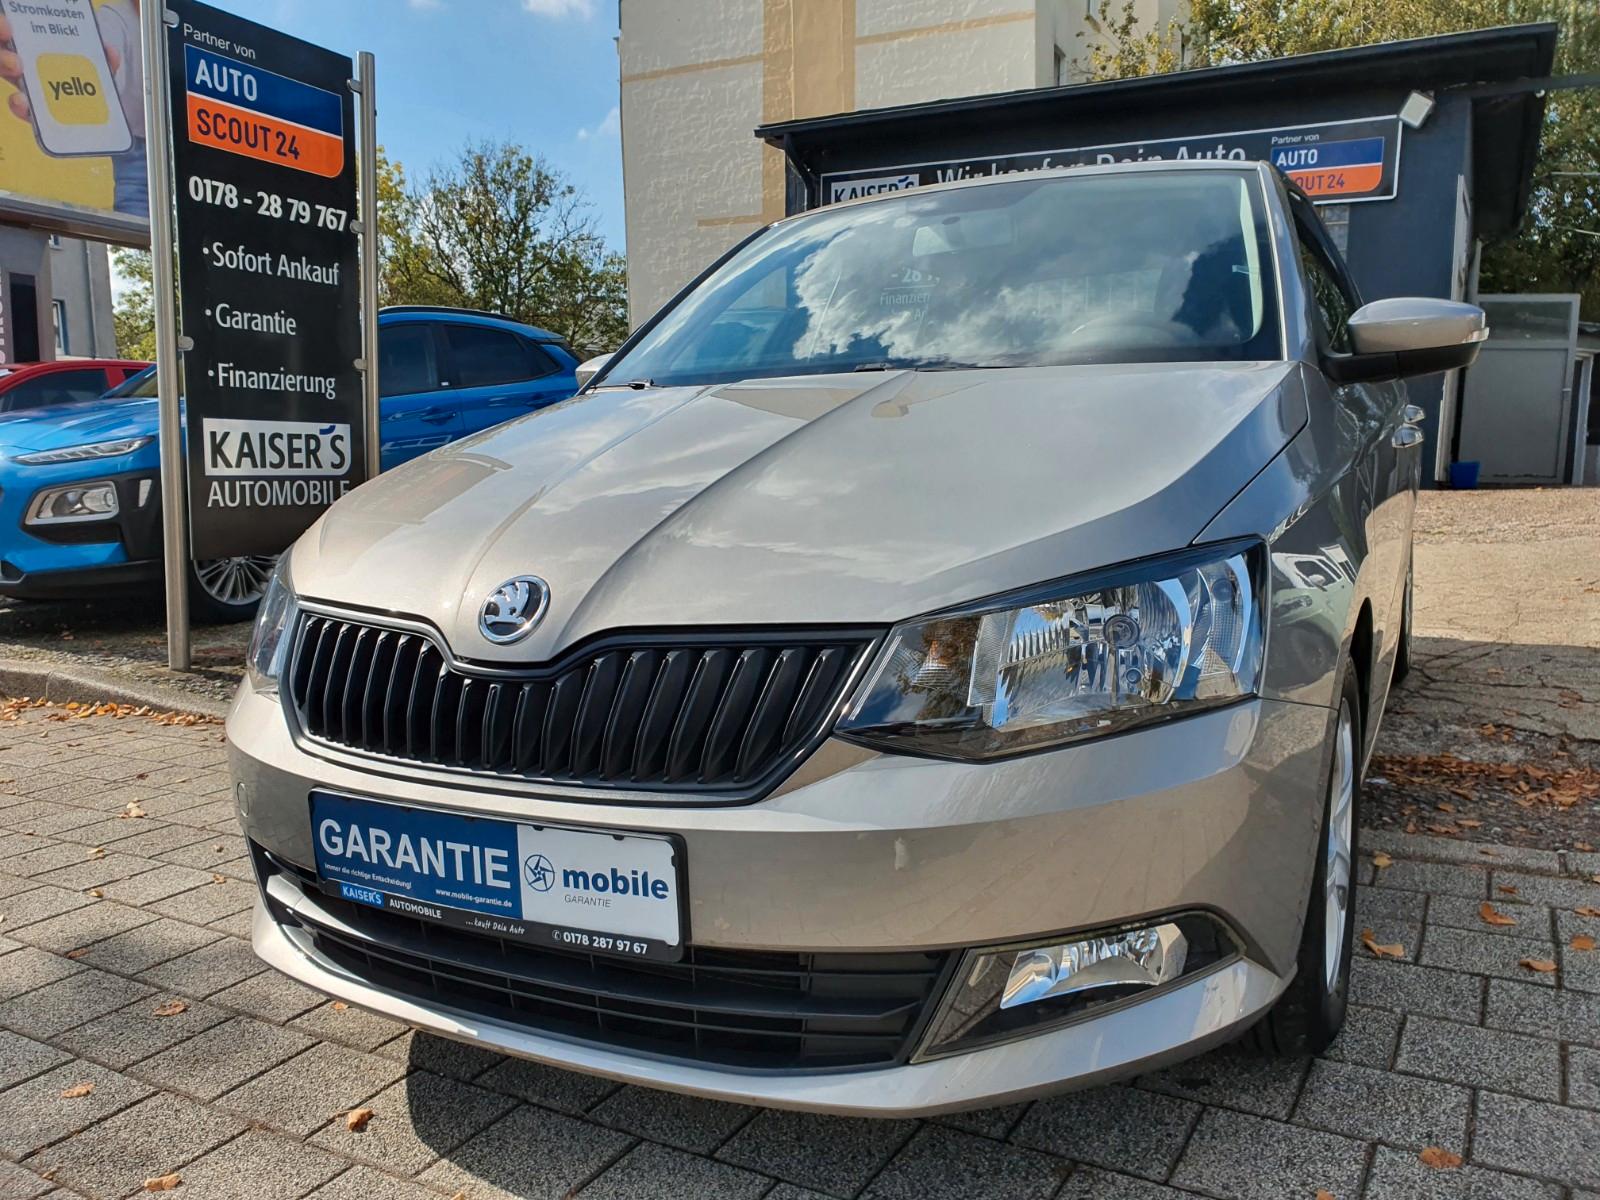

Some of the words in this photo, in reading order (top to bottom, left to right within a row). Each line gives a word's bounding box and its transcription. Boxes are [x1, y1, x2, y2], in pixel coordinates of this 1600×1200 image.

[9, 2, 85, 20] Stromkosten
[30, 21, 47, 34] im
[49, 23, 80, 37] Blick!
[183, 24, 231, 51] Partner
[233, 45, 256, 60] von
[49, 77, 97, 100] yello
[195, 59, 258, 101] AUTO
[1271, 135, 1302, 145] Partner
[1304, 133, 1320, 142] von
[1276, 149, 1318, 167] AUTO
[1294, 175, 1325, 191] OUT
[189, 175, 238, 209] 0178
[257, 191, 283, 218] 28
[287, 200, 311, 223] 79
[314, 205, 348, 231] 767
[212, 241, 272, 276] Sofort
[277, 252, 340, 286] Ankauf
[215, 303, 297, 336] Garantie
[217, 363, 336, 400] Finanzierung
[209, 425, 346, 470] KAISER'S
[319, 818, 511, 889] GARANTIE
[562, 866, 669, 900] mobile
[389, 898, 442, 919] AUTOMOBILE
[435, 889, 512, 908] www.mobile-garantie.de
[564, 894, 612, 908] GARANTIE
[492, 922, 507, 932] Dein
[509, 924, 525, 935] Auto
[563, 931, 589, 946] 0178
[592, 936, 613, 949] 287
[616, 939, 632, 952] 97
[633, 942, 648, 955] 67
